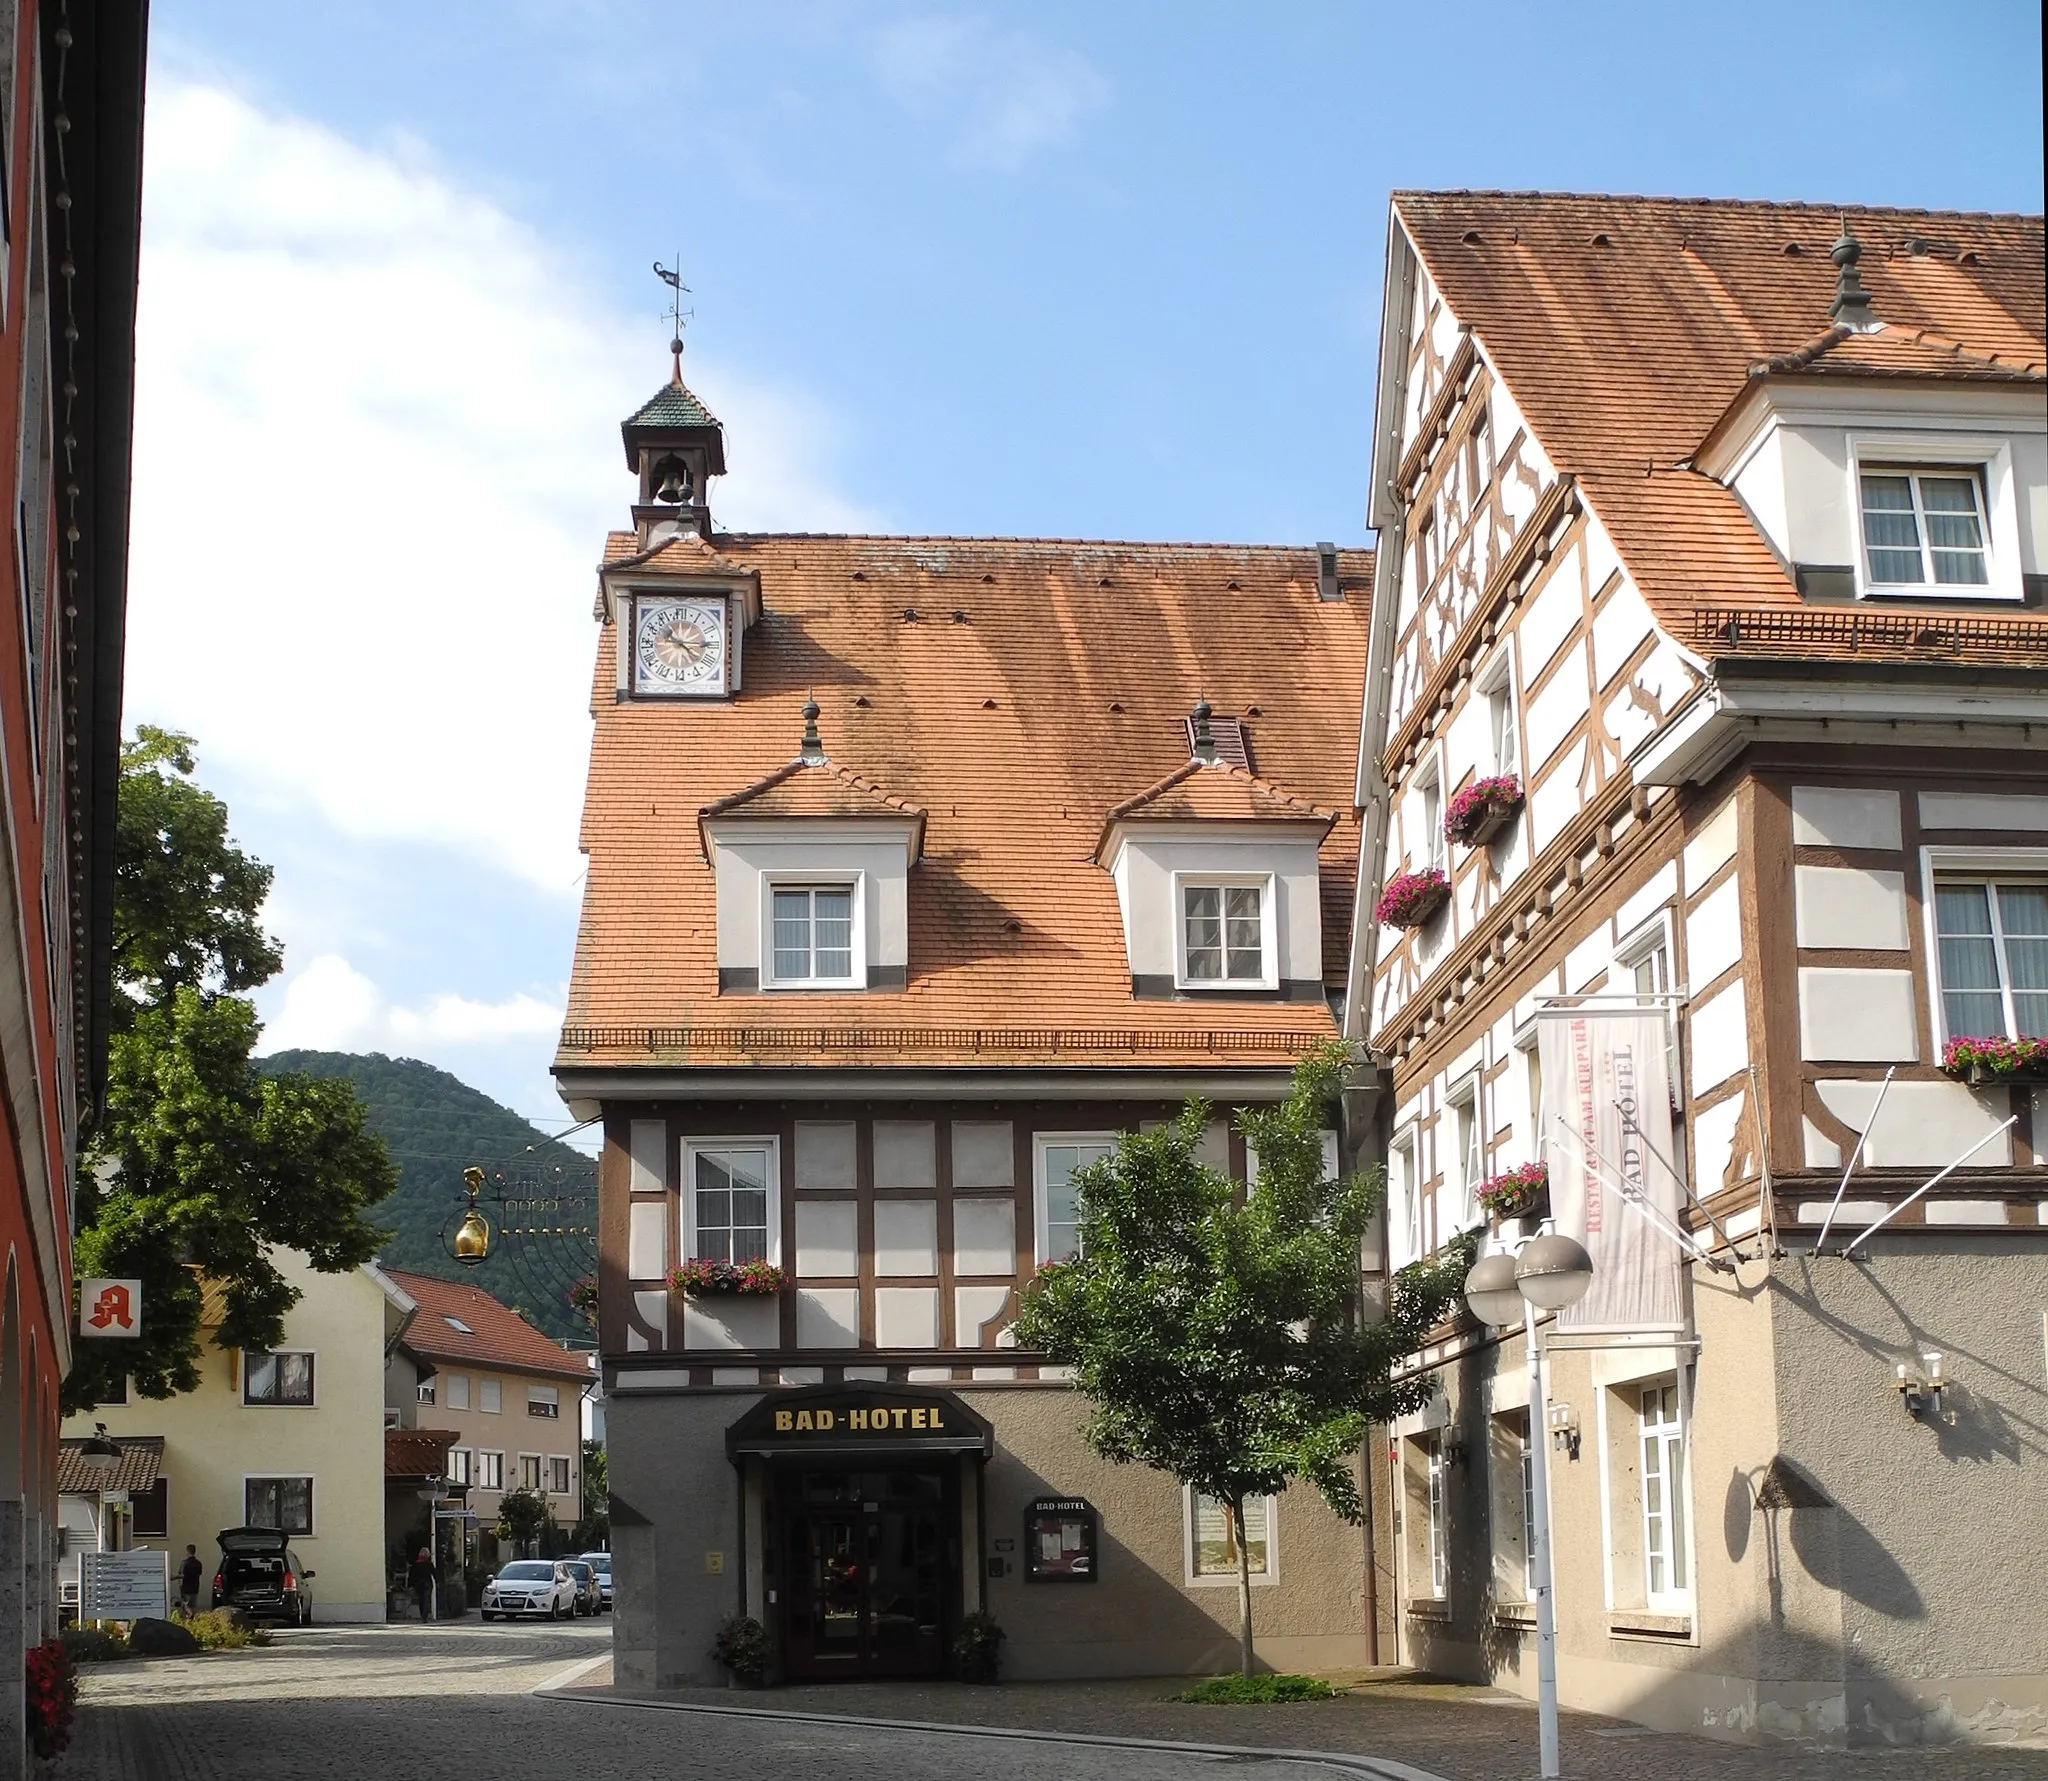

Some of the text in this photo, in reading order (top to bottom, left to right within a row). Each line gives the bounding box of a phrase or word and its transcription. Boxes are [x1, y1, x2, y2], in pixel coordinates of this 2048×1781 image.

[1571, 1019, 1592, 1095] KURPARK
[1582, 1100, 1595, 1124] AM
[1613, 1044, 1645, 1206] BAD HOTEL
